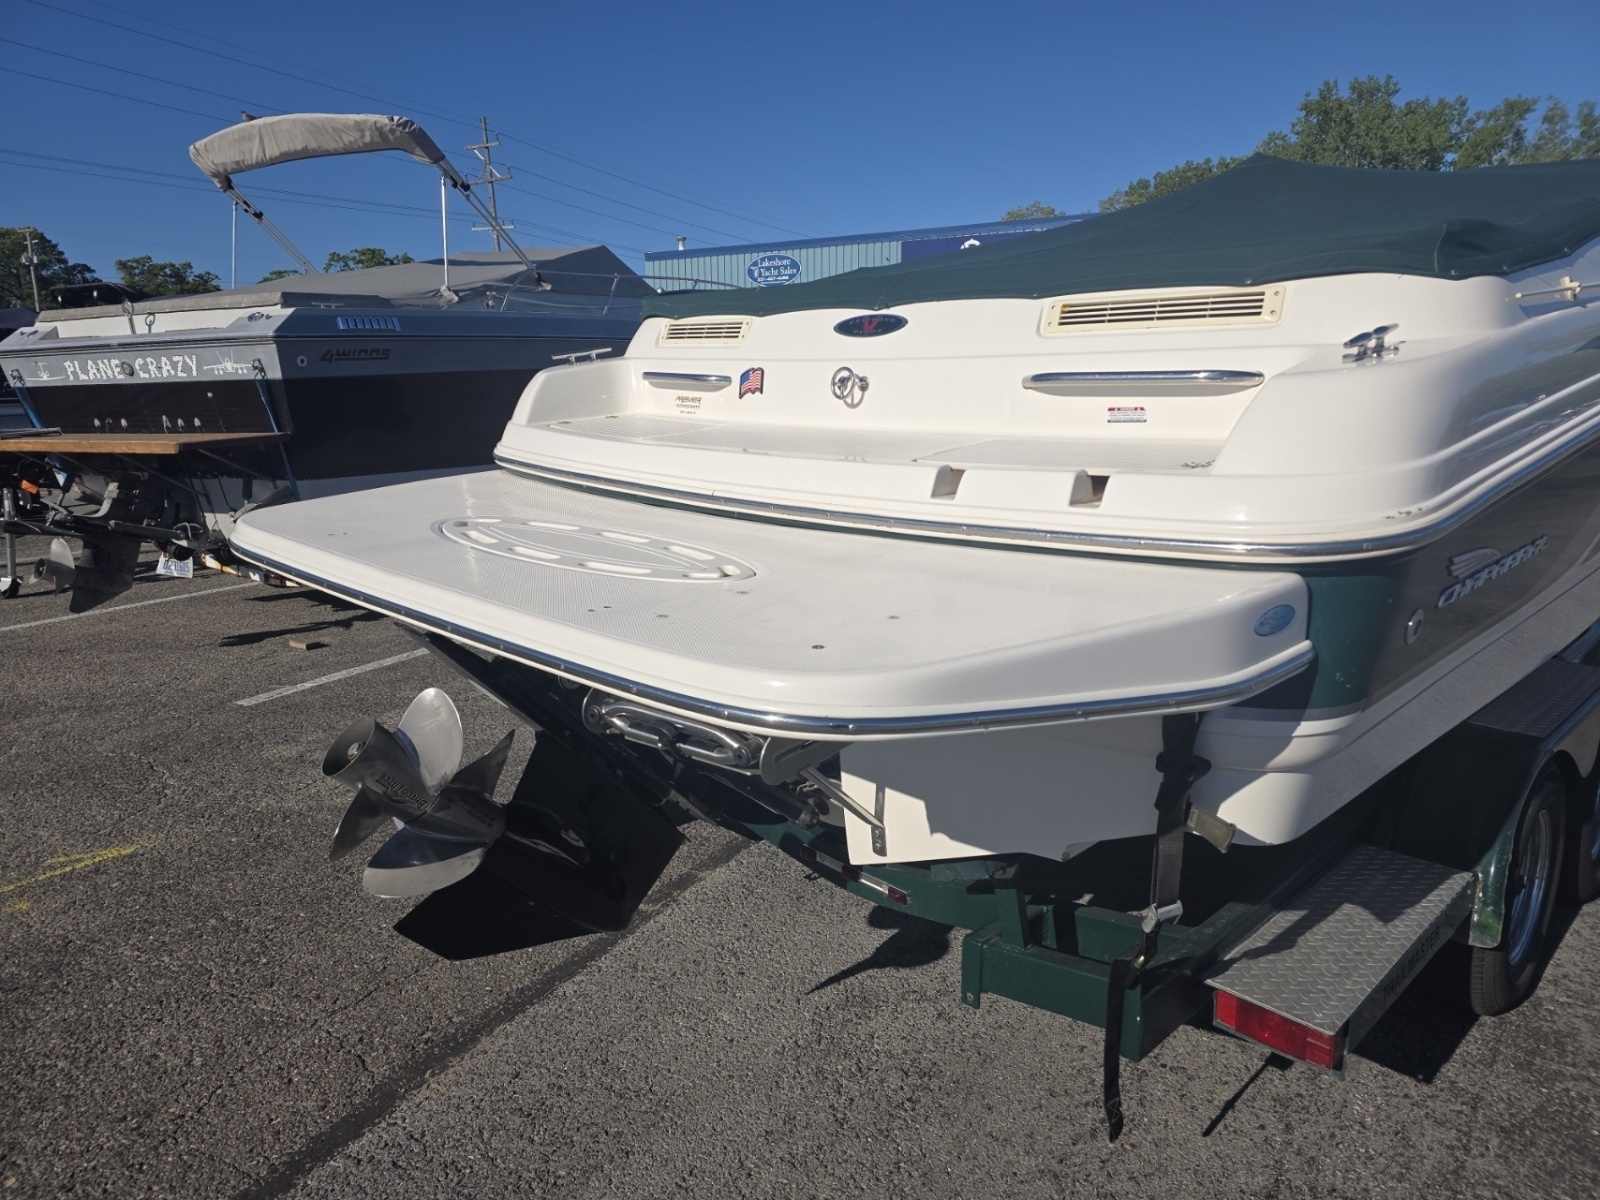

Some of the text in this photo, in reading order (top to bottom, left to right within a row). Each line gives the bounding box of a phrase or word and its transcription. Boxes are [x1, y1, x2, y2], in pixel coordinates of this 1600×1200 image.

[757, 257, 791, 267] Lakeshore
[760, 266, 797, 277] Yacht Sales
[63, 354, 198, 381] PLANE CRAZY
[1382, 925, 1441, 1002] TRAILMASTER
